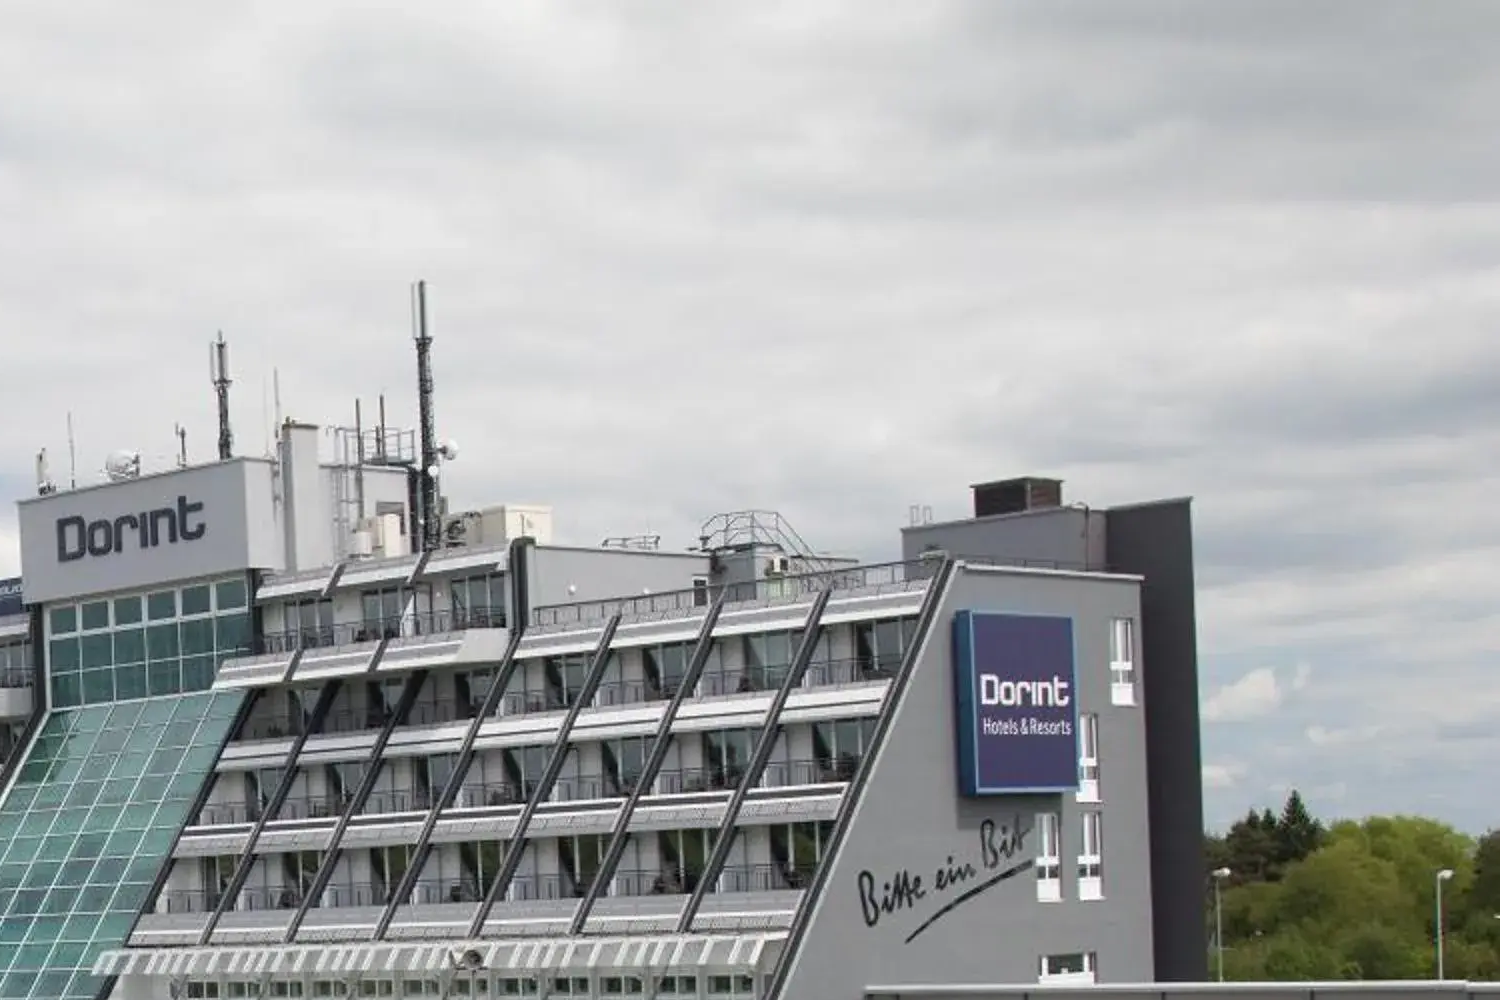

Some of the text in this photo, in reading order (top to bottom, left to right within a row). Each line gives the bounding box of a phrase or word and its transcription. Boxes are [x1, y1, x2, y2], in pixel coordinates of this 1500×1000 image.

[57, 495, 206, 562] Dorint
[980, 673, 1069, 707] Dorint
[983, 717, 1071, 735] Hotels & Resorts
[858, 814, 1032, 928] Bitte ein Bit
